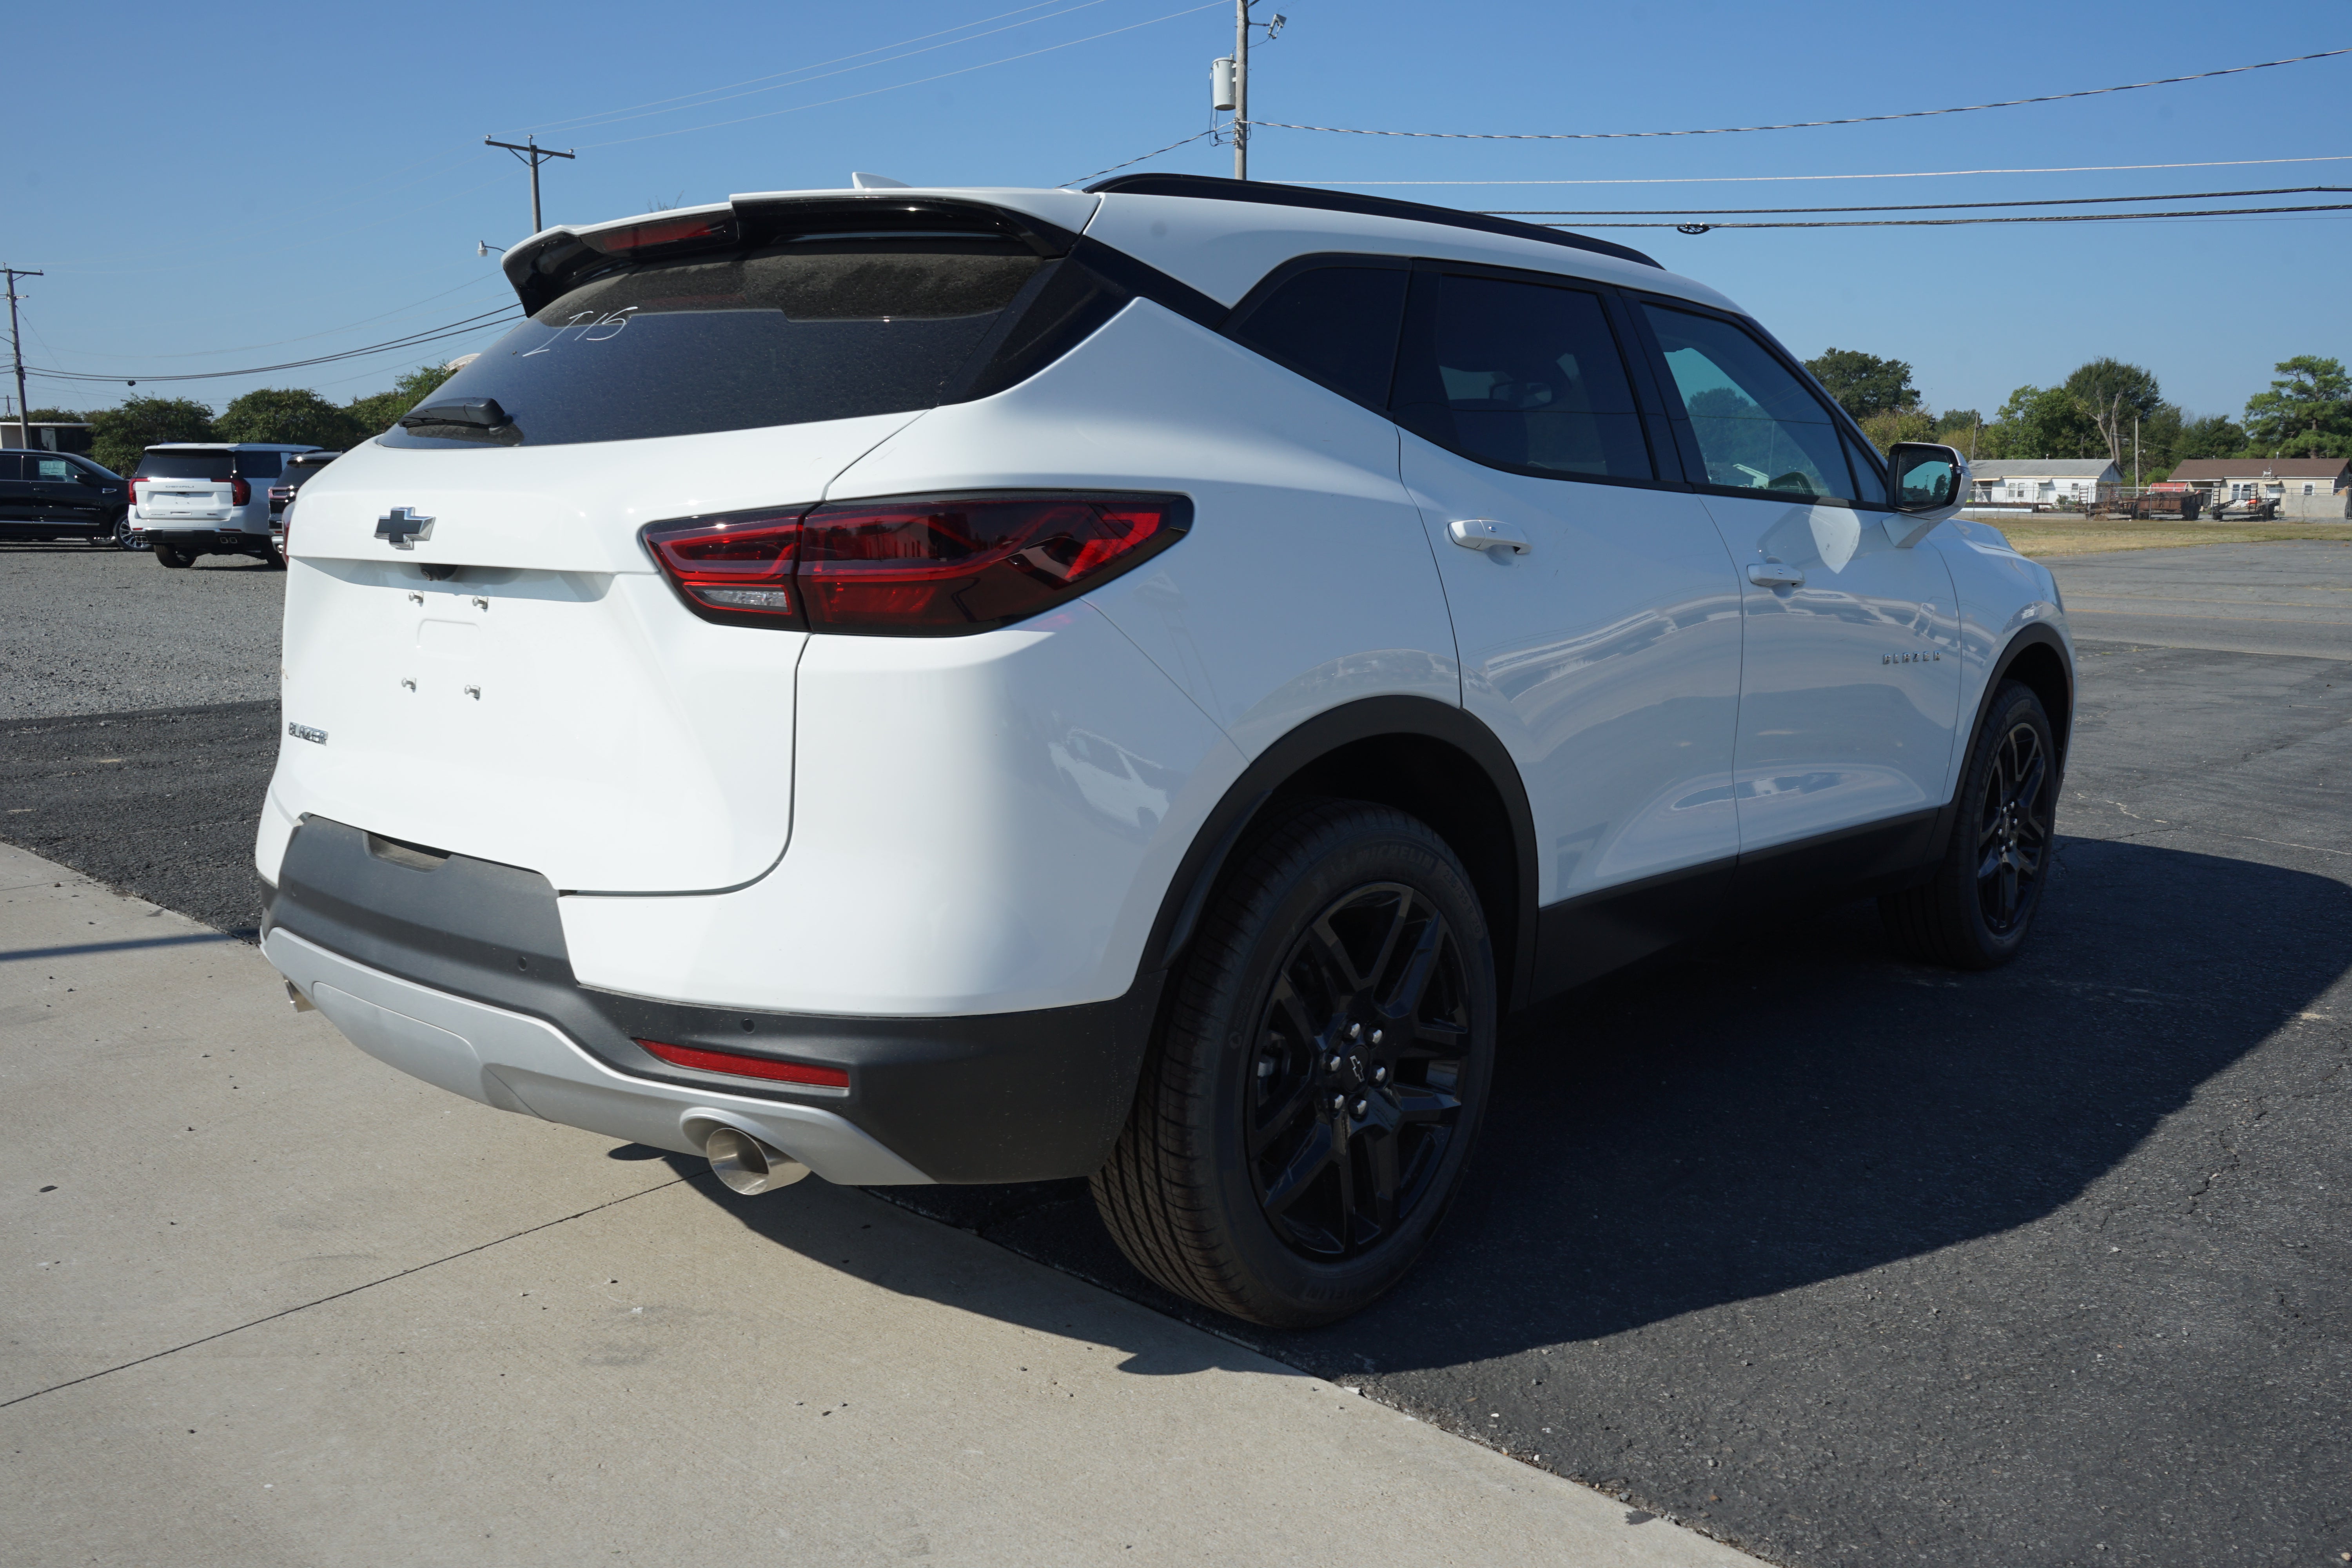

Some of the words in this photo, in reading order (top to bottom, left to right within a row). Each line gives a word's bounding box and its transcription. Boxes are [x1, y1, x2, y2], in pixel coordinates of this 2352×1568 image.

[1883, 650, 1941, 665] BLAZER
[289, 722, 328, 746] BLAZER
[1356, 845, 1436, 869] MICHELIN
